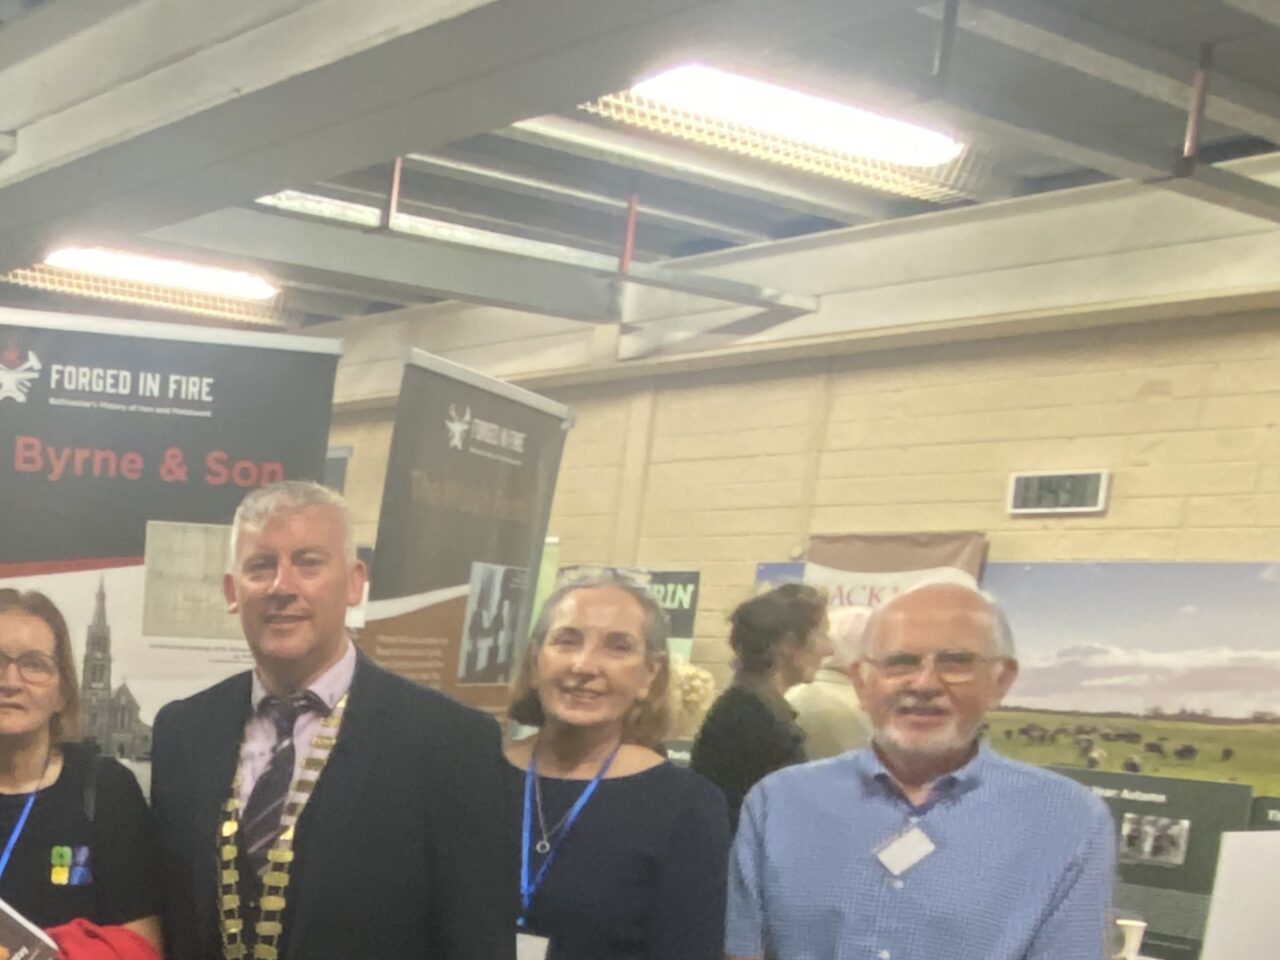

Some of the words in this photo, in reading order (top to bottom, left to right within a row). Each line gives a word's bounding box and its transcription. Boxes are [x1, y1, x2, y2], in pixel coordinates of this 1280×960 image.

[50, 364, 131, 396] FORGED
[138, 371, 161, 398] IN
[168, 374, 214, 402] FIRE
[14, 434, 144, 482] Byrne
[159, 446, 187, 482] &
[204, 449, 284, 488] Son
